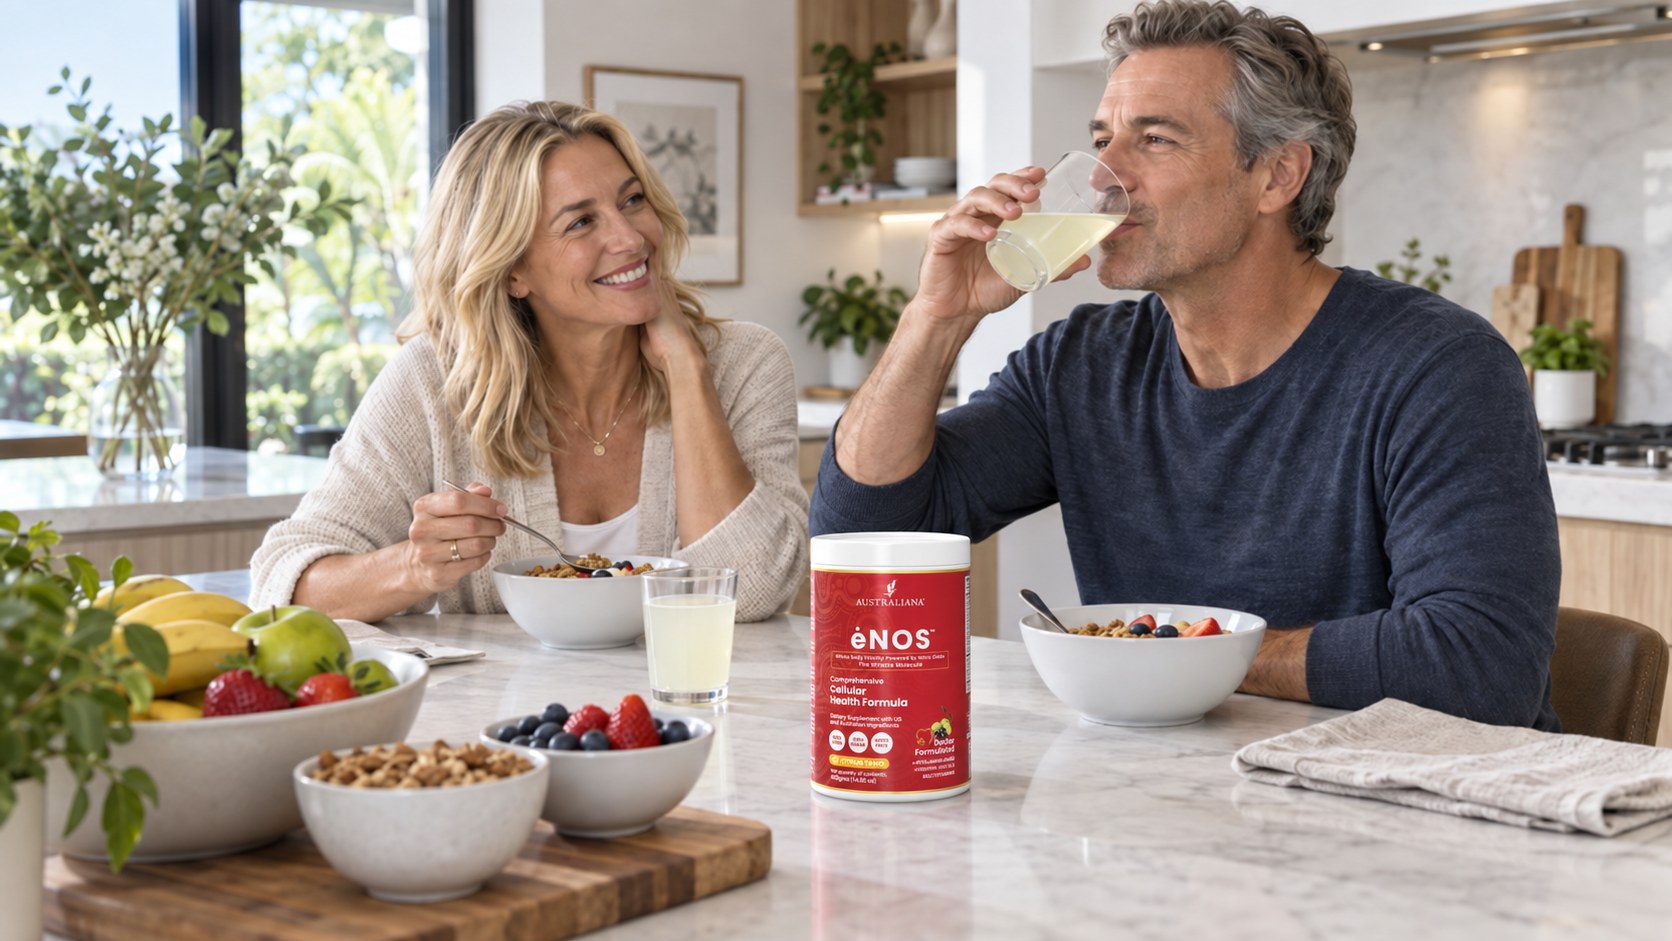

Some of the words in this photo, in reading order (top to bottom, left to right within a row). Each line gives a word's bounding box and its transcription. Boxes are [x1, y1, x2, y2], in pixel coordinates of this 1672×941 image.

[856, 598, 925, 607] AUSTRALIANA
[830, 685, 867, 695] Cellular
[830, 695, 860, 706] Health
[862, 698, 908, 708] Formula
